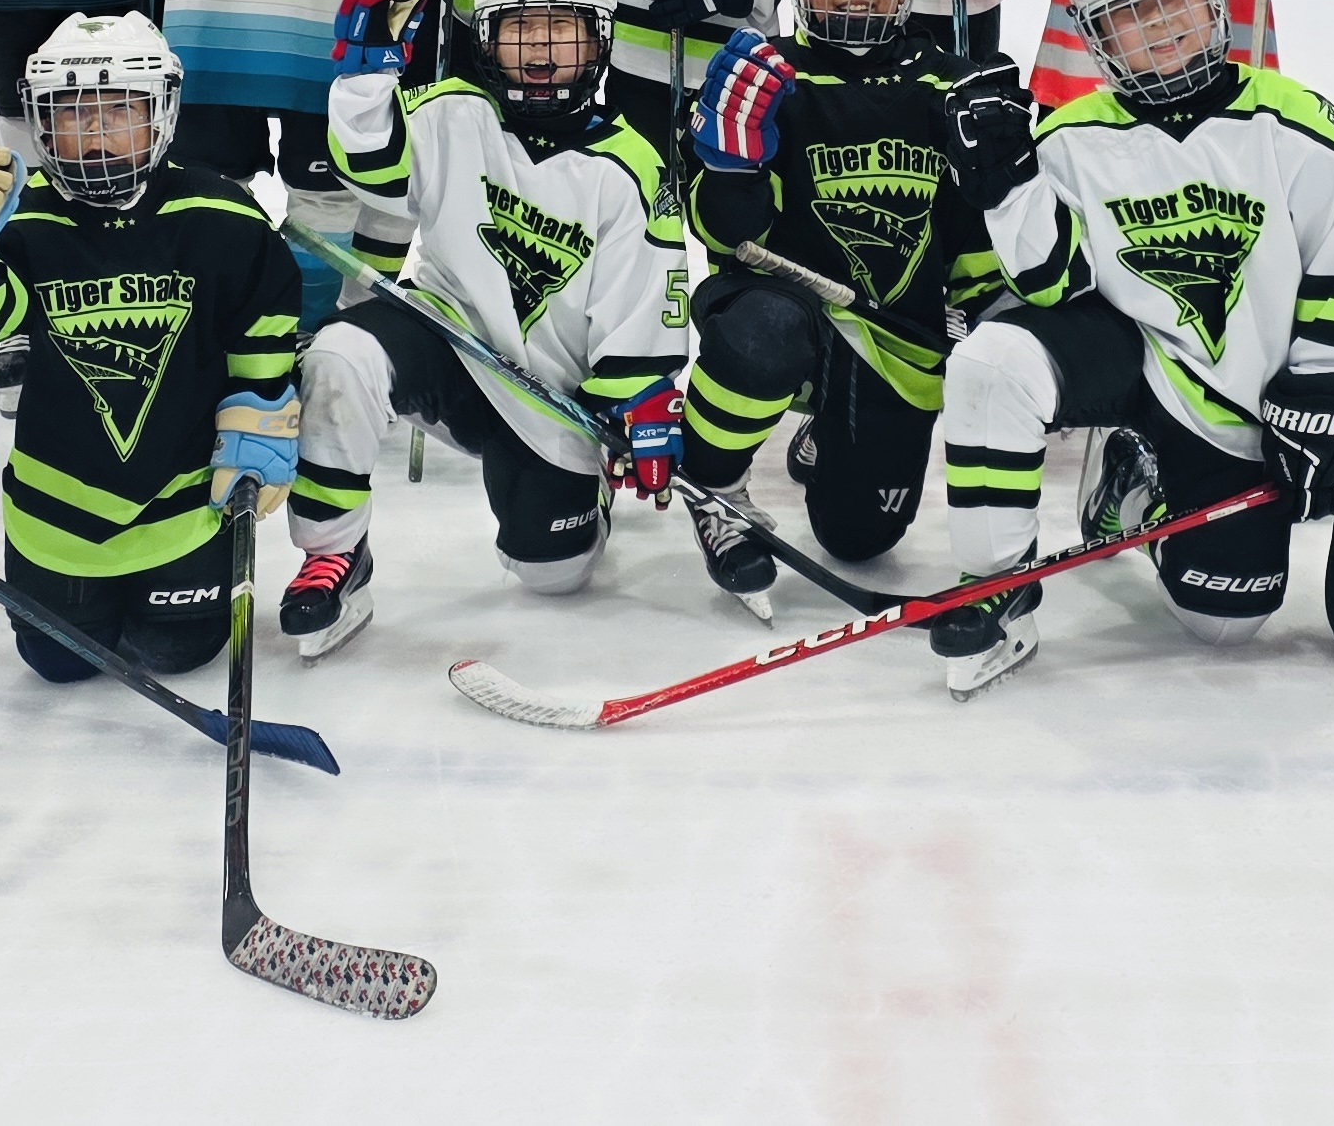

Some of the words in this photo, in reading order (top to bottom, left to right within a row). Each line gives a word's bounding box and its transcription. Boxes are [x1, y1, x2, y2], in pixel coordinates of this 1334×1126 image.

[60, 55, 114, 67] BAUER
[1105, 191, 1180, 229] Tiger
[1185, 182, 1267, 227] Sharks
[35, 279, 116, 314] Tiger
[661, 269, 690, 329] 5
[550, 506, 598, 532] BAUE
[1010, 518, 1160, 575] JETSPEED
[148, 586, 221, 608] CCM
[1181, 568, 1284, 594] BAUER
[755, 604, 902, 666] CCM
